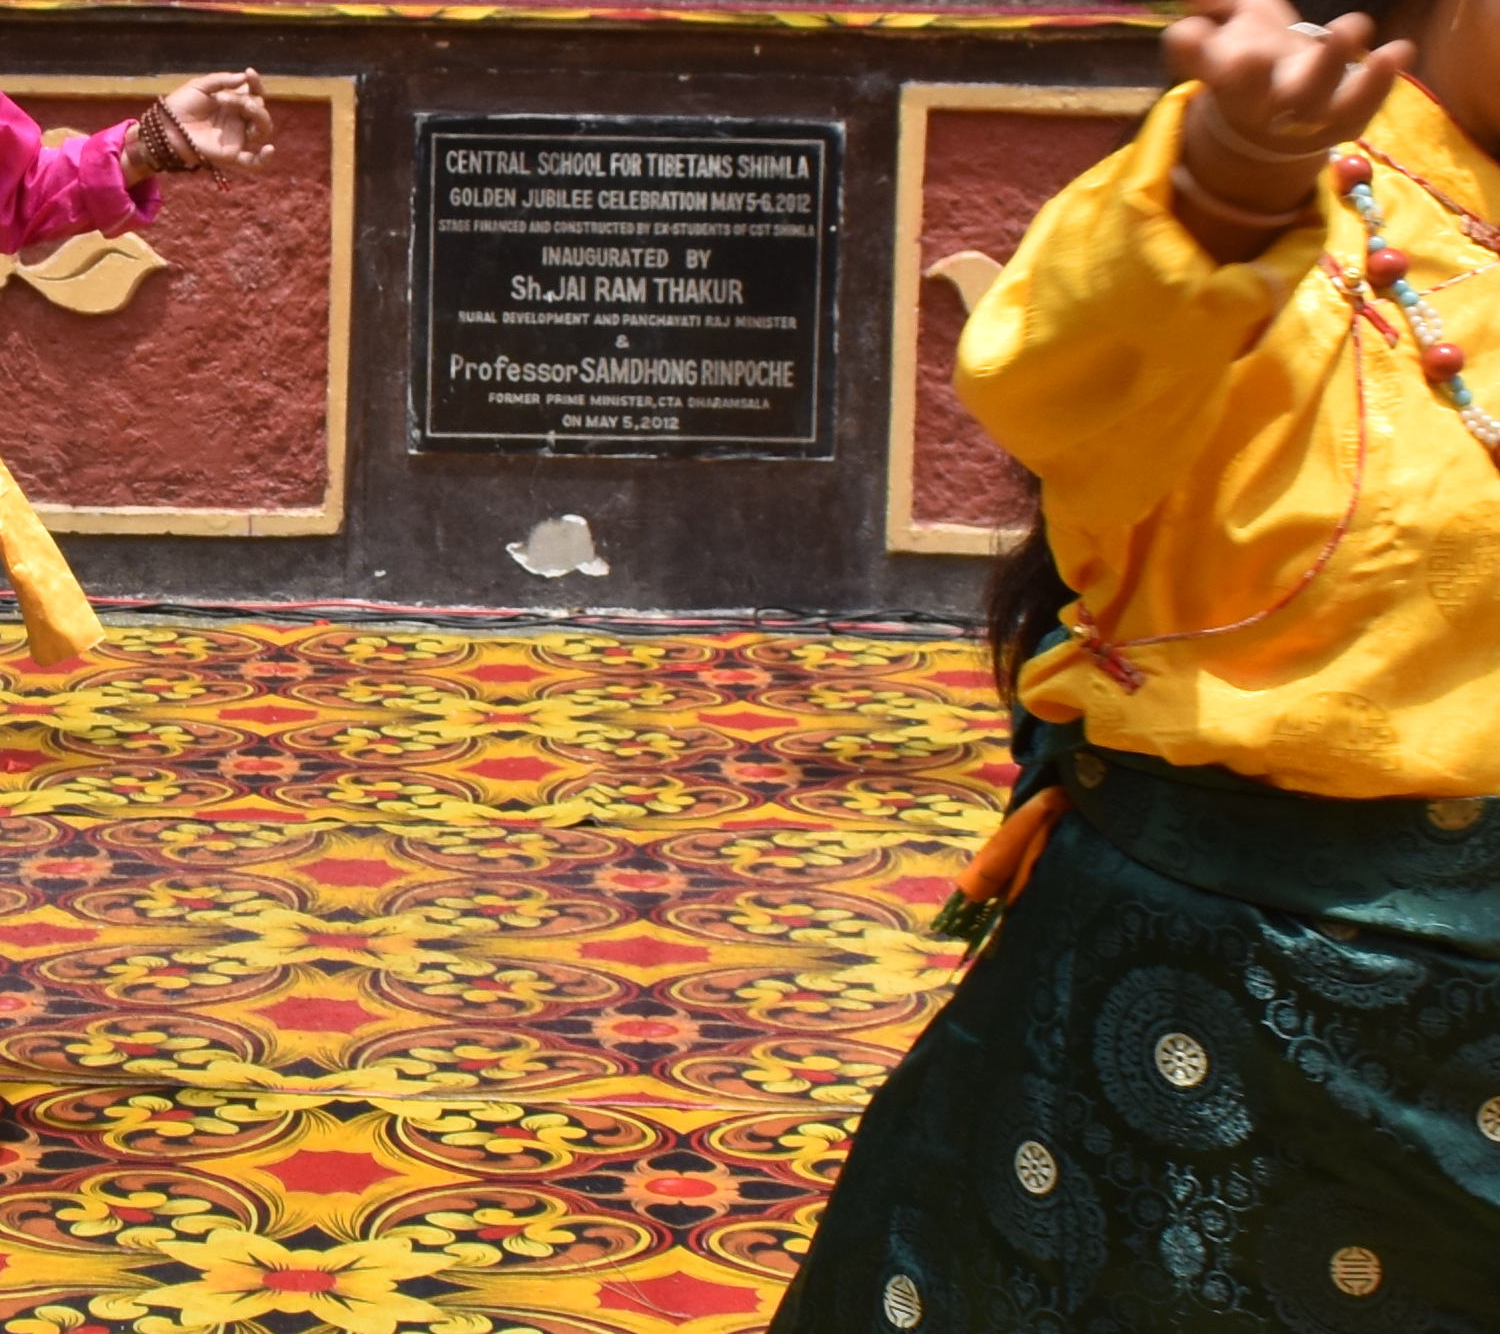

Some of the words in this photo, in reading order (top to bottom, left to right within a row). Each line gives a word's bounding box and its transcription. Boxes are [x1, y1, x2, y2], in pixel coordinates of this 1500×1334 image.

[445, 148, 532, 176] CENTRAL
[537, 150, 607, 178] SCHOOL
[609, 152, 643, 178] FOR
[645, 153, 734, 179] TIBETANS
[736, 154, 810, 180] SHIMLA
[449, 186, 517, 208] GOLDEN
[520, 188, 594, 209] JUBILEE
[597, 189, 708, 212] CELEBRATION
[710, 191, 746, 212] MAY
[437, 218, 472, 233] STAGE
[473, 218, 527, 234] FINANCED
[528, 219, 551, 234] AND
[553, 220, 635, 235] CONSTRUCTED
[636, 221, 651, 235] BY
[653, 221, 732, 237] EX-STUDENTS
[733, 223, 748, 237] OF
[750, 223, 771, 237] CST
[773, 223, 816, 238] SHIMLA
[541, 245, 669, 269] INAUGURATED
[685, 248, 712, 270] BY
[594, 275, 648, 303] RAM
[653, 276, 744, 305] THAKUR
[457, 309, 498, 324] RURAL
[502, 310, 590, 326] DEVELOPMENT
[593, 312, 620, 326] AND
[621, 313, 701, 328] PANCHAYATI
[704, 314, 732, 328] RAJ
[734, 315, 798, 330] MINISTER
[614, 333, 631, 349] &
[450, 352, 579, 384] Professor
[579, 356, 699, 386] SAMDHONG
[700, 358, 796, 388] RINPOCHE
[487, 391, 541, 405] FORMER
[545, 393, 586, 406] PRIME
[687, 396, 772, 410] DHARAMSALA
[561, 413, 582, 428] ON
[585, 415, 619, 429] MAY
